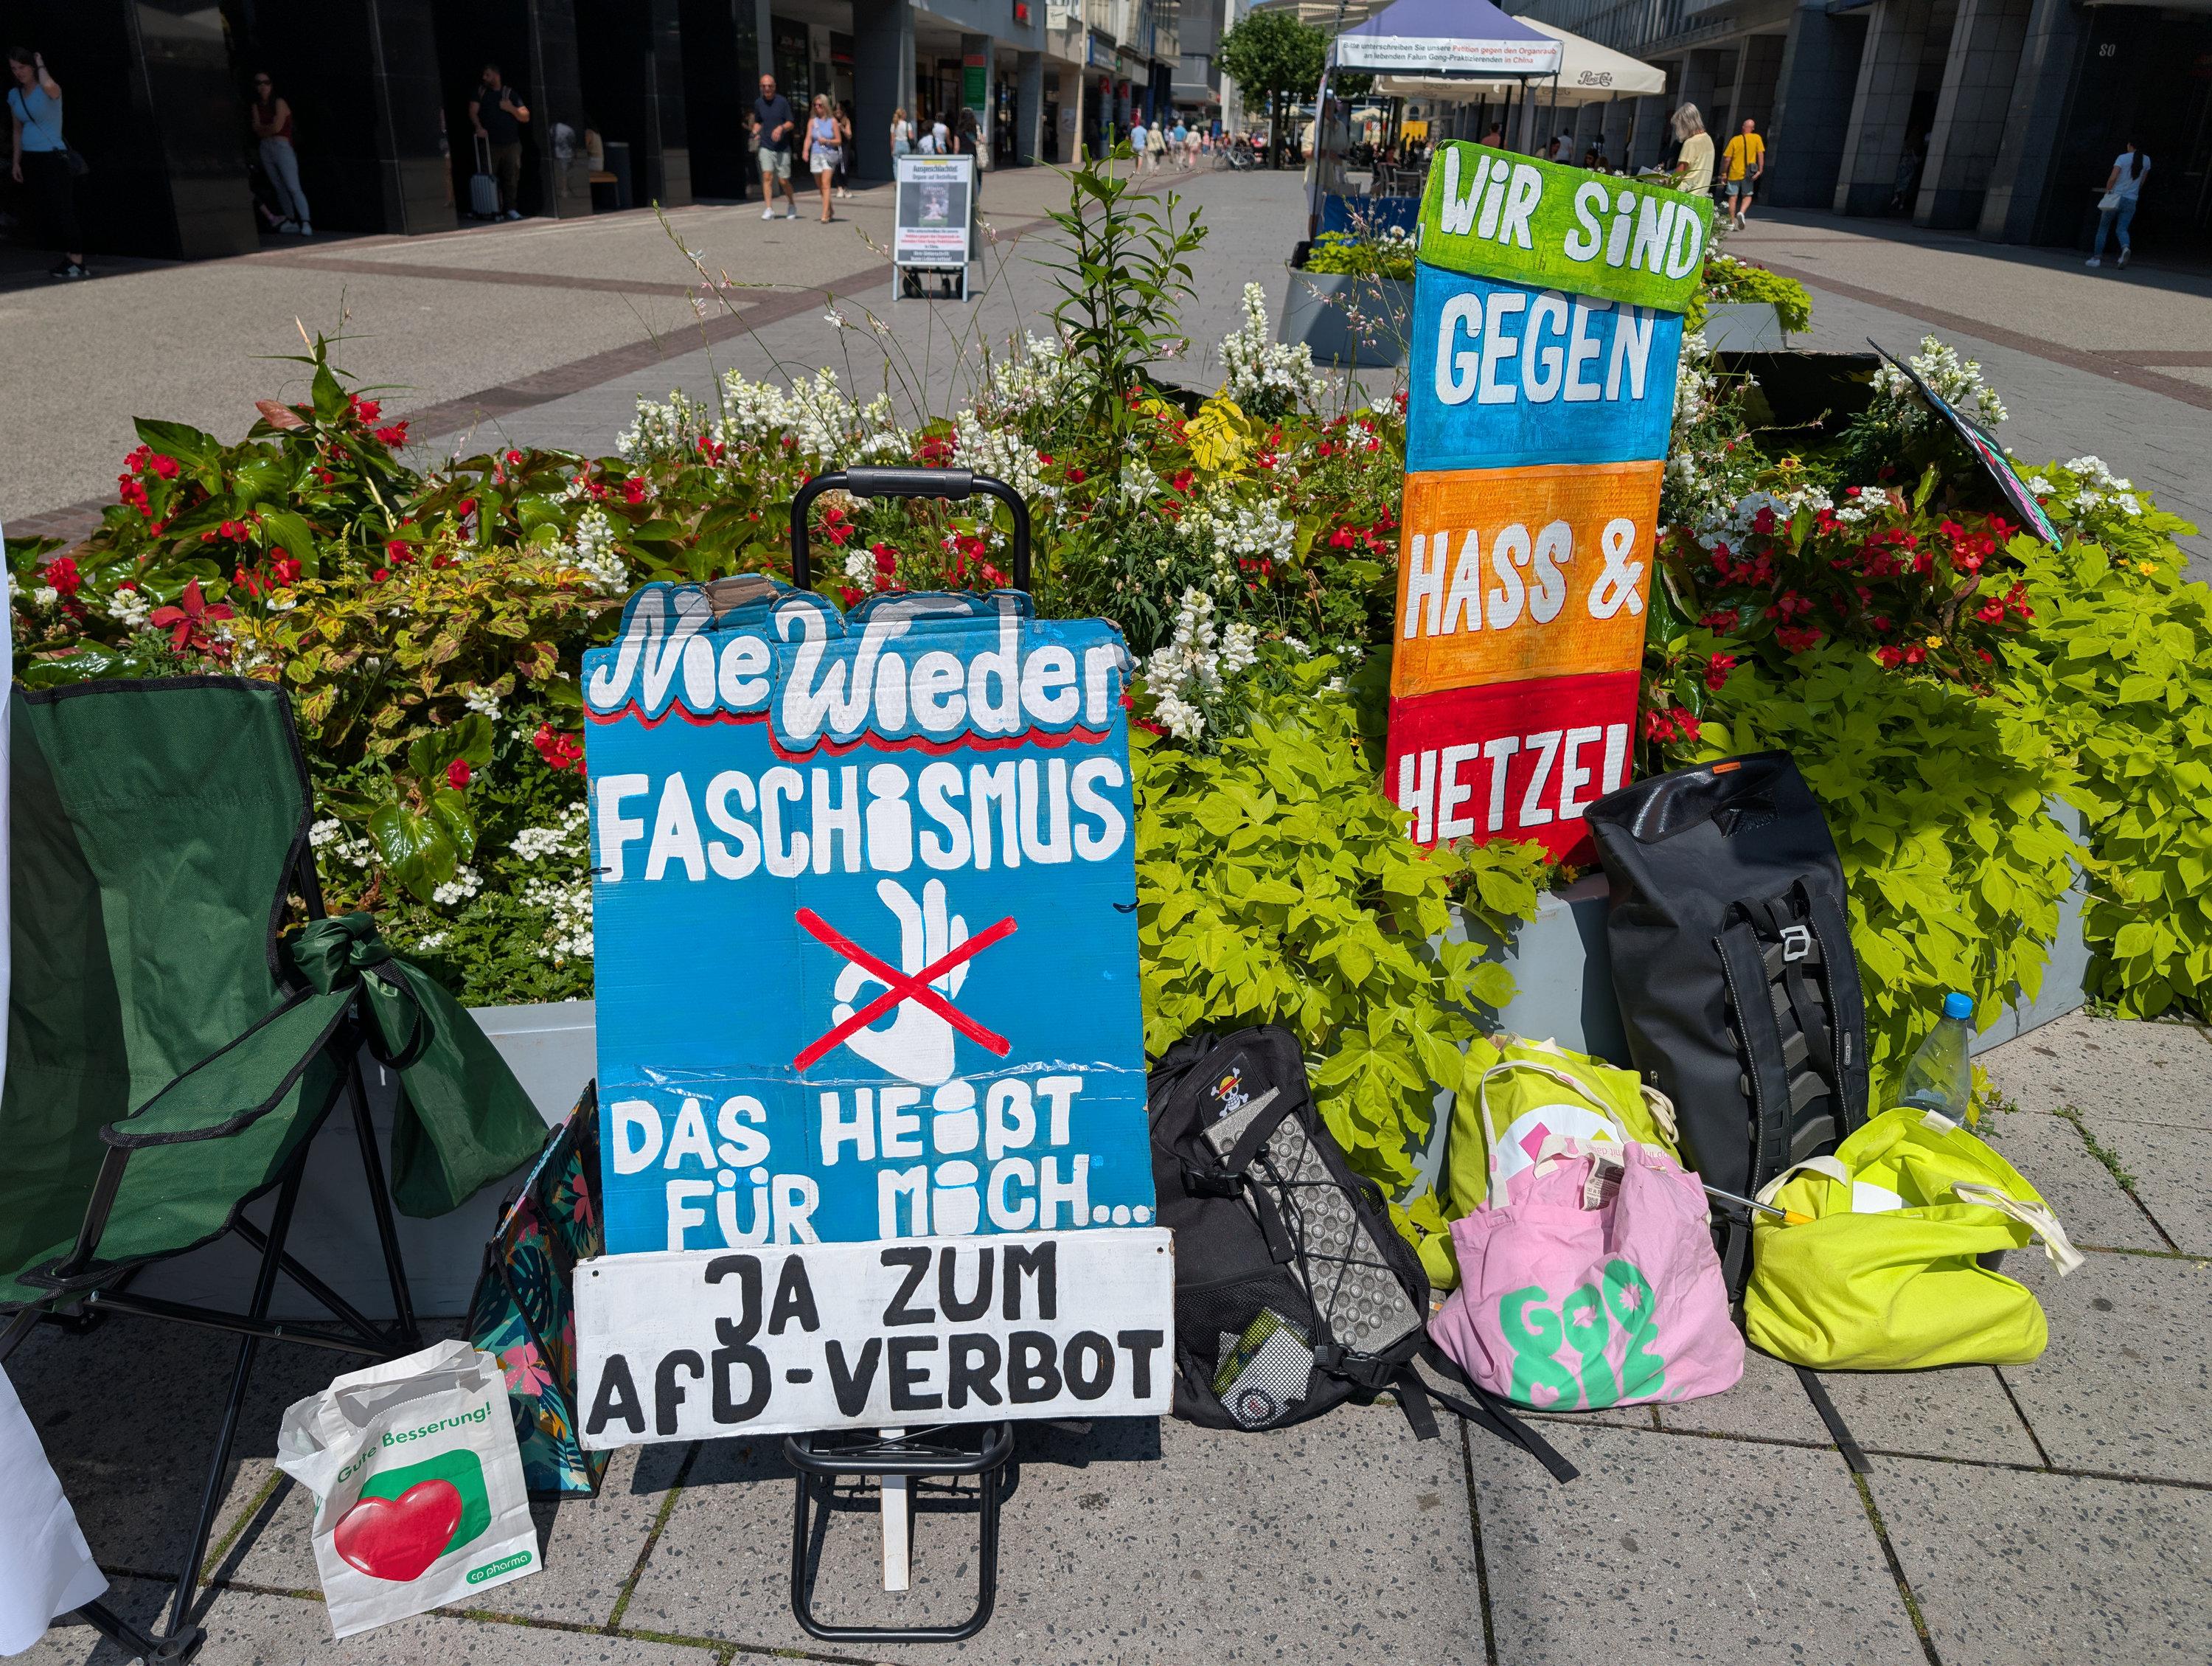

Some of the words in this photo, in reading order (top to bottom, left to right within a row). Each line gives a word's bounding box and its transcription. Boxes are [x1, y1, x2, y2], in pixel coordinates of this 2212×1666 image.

[1360, 42, 1413, 51] unterschreiben
[1481, 46, 1503, 55] gegen
[1518, 47, 1557, 55] Organraub
[1435, 290, 1656, 405] GEGEN
[1403, 519, 1573, 639] HASS
[1587, 518, 1644, 619] &
[588, 589, 771, 713] Nie
[775, 596, 1133, 739] Wieder
[610, 1094, 771, 1175] DAS
[665, 1167, 821, 1252] FÜR
[703, 1254, 821, 1346] JA
[880, 1240, 1057, 1327] ZUM
[585, 1329, 1164, 1436] AfD-VERBOT
[337, 1445, 378, 1484] Gute
[382, 1401, 493, 1448] Besserung!
[471, 1571, 484, 1581] cp
[487, 1555, 528, 1577] pharma
